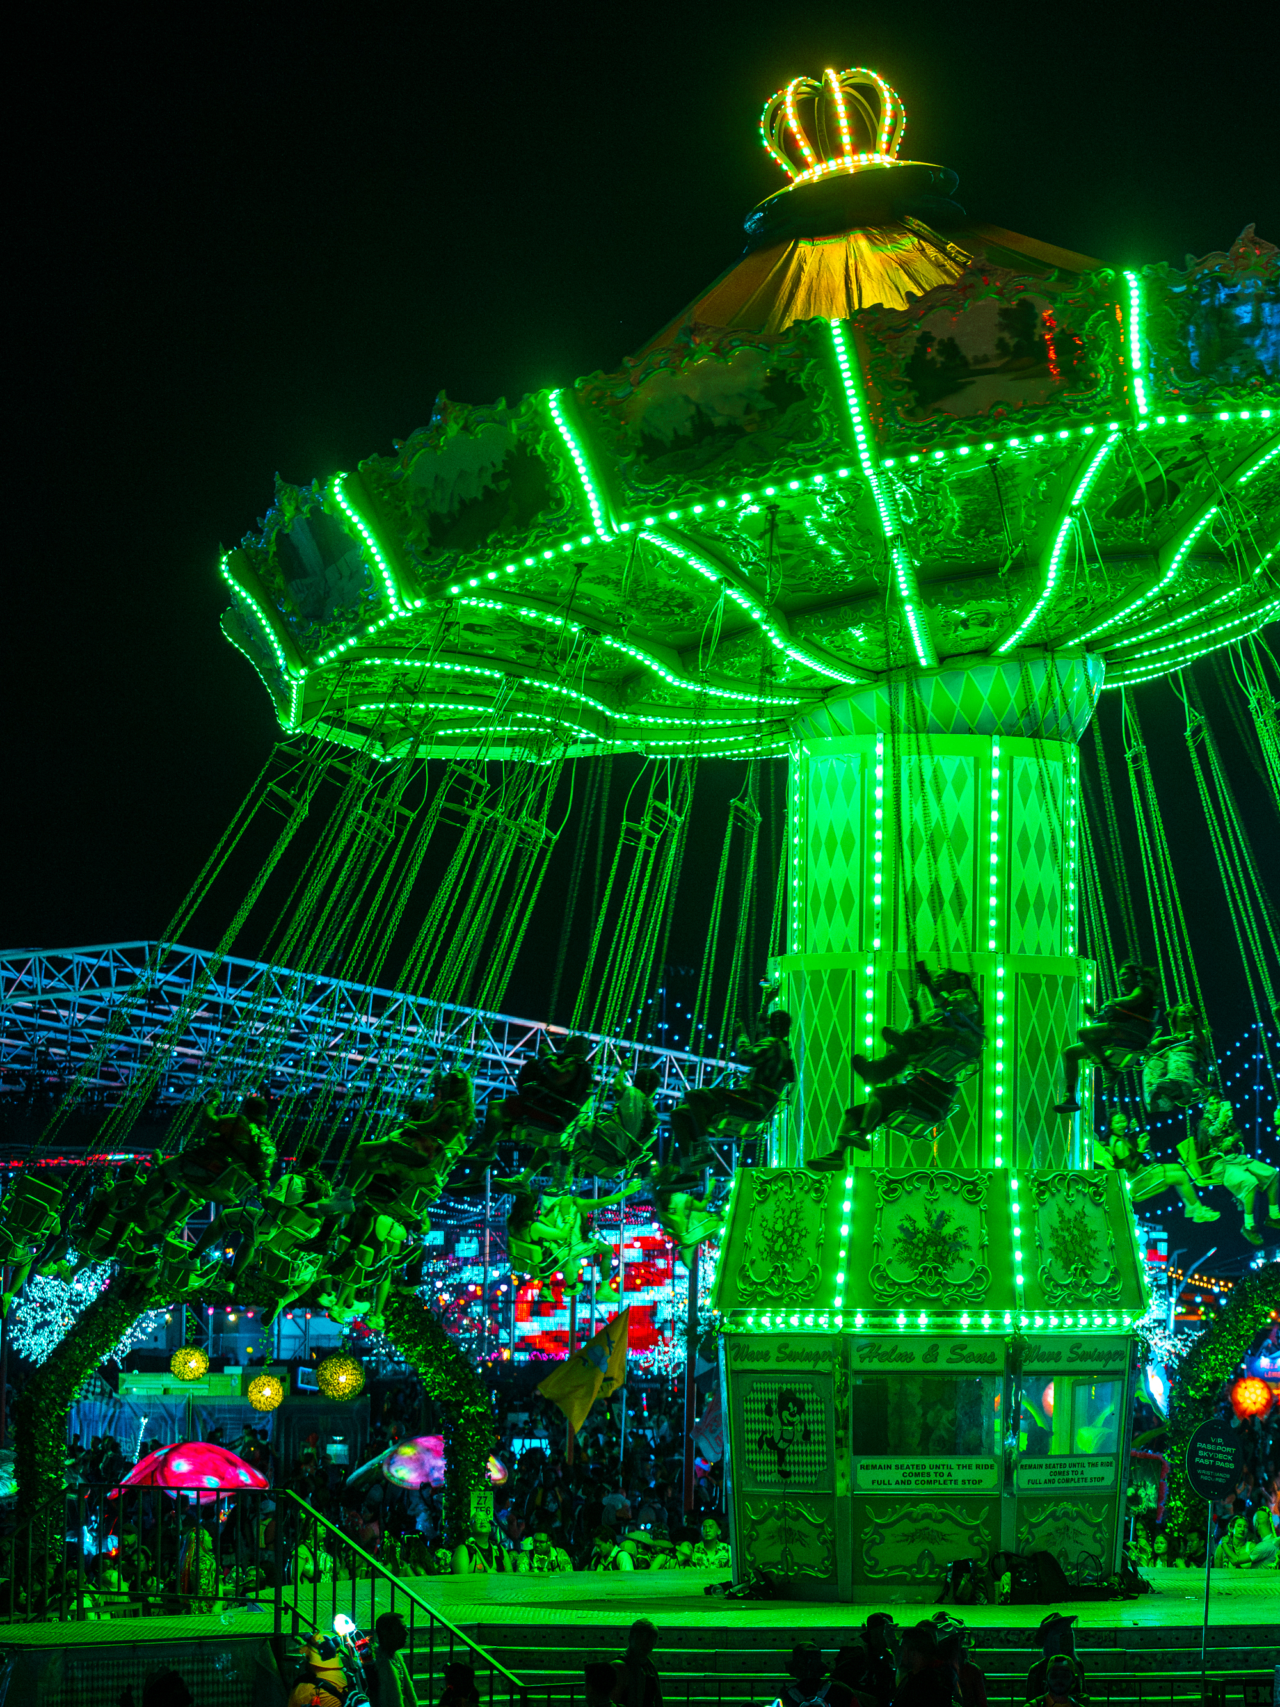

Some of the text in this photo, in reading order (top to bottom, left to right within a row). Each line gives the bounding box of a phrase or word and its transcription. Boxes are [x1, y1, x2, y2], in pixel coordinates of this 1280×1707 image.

[730, 1343, 832, 1368] Wave Swinger
[856, 1343, 997, 1364] Helm & Sons
[1022, 1342, 1126, 1368] Wave Swinger
[1196, 1442, 1236, 1453] PASSPORT
[1198, 1450, 1233, 1461] SKYDECK
[1195, 1457, 1235, 1469] FAST PASS
